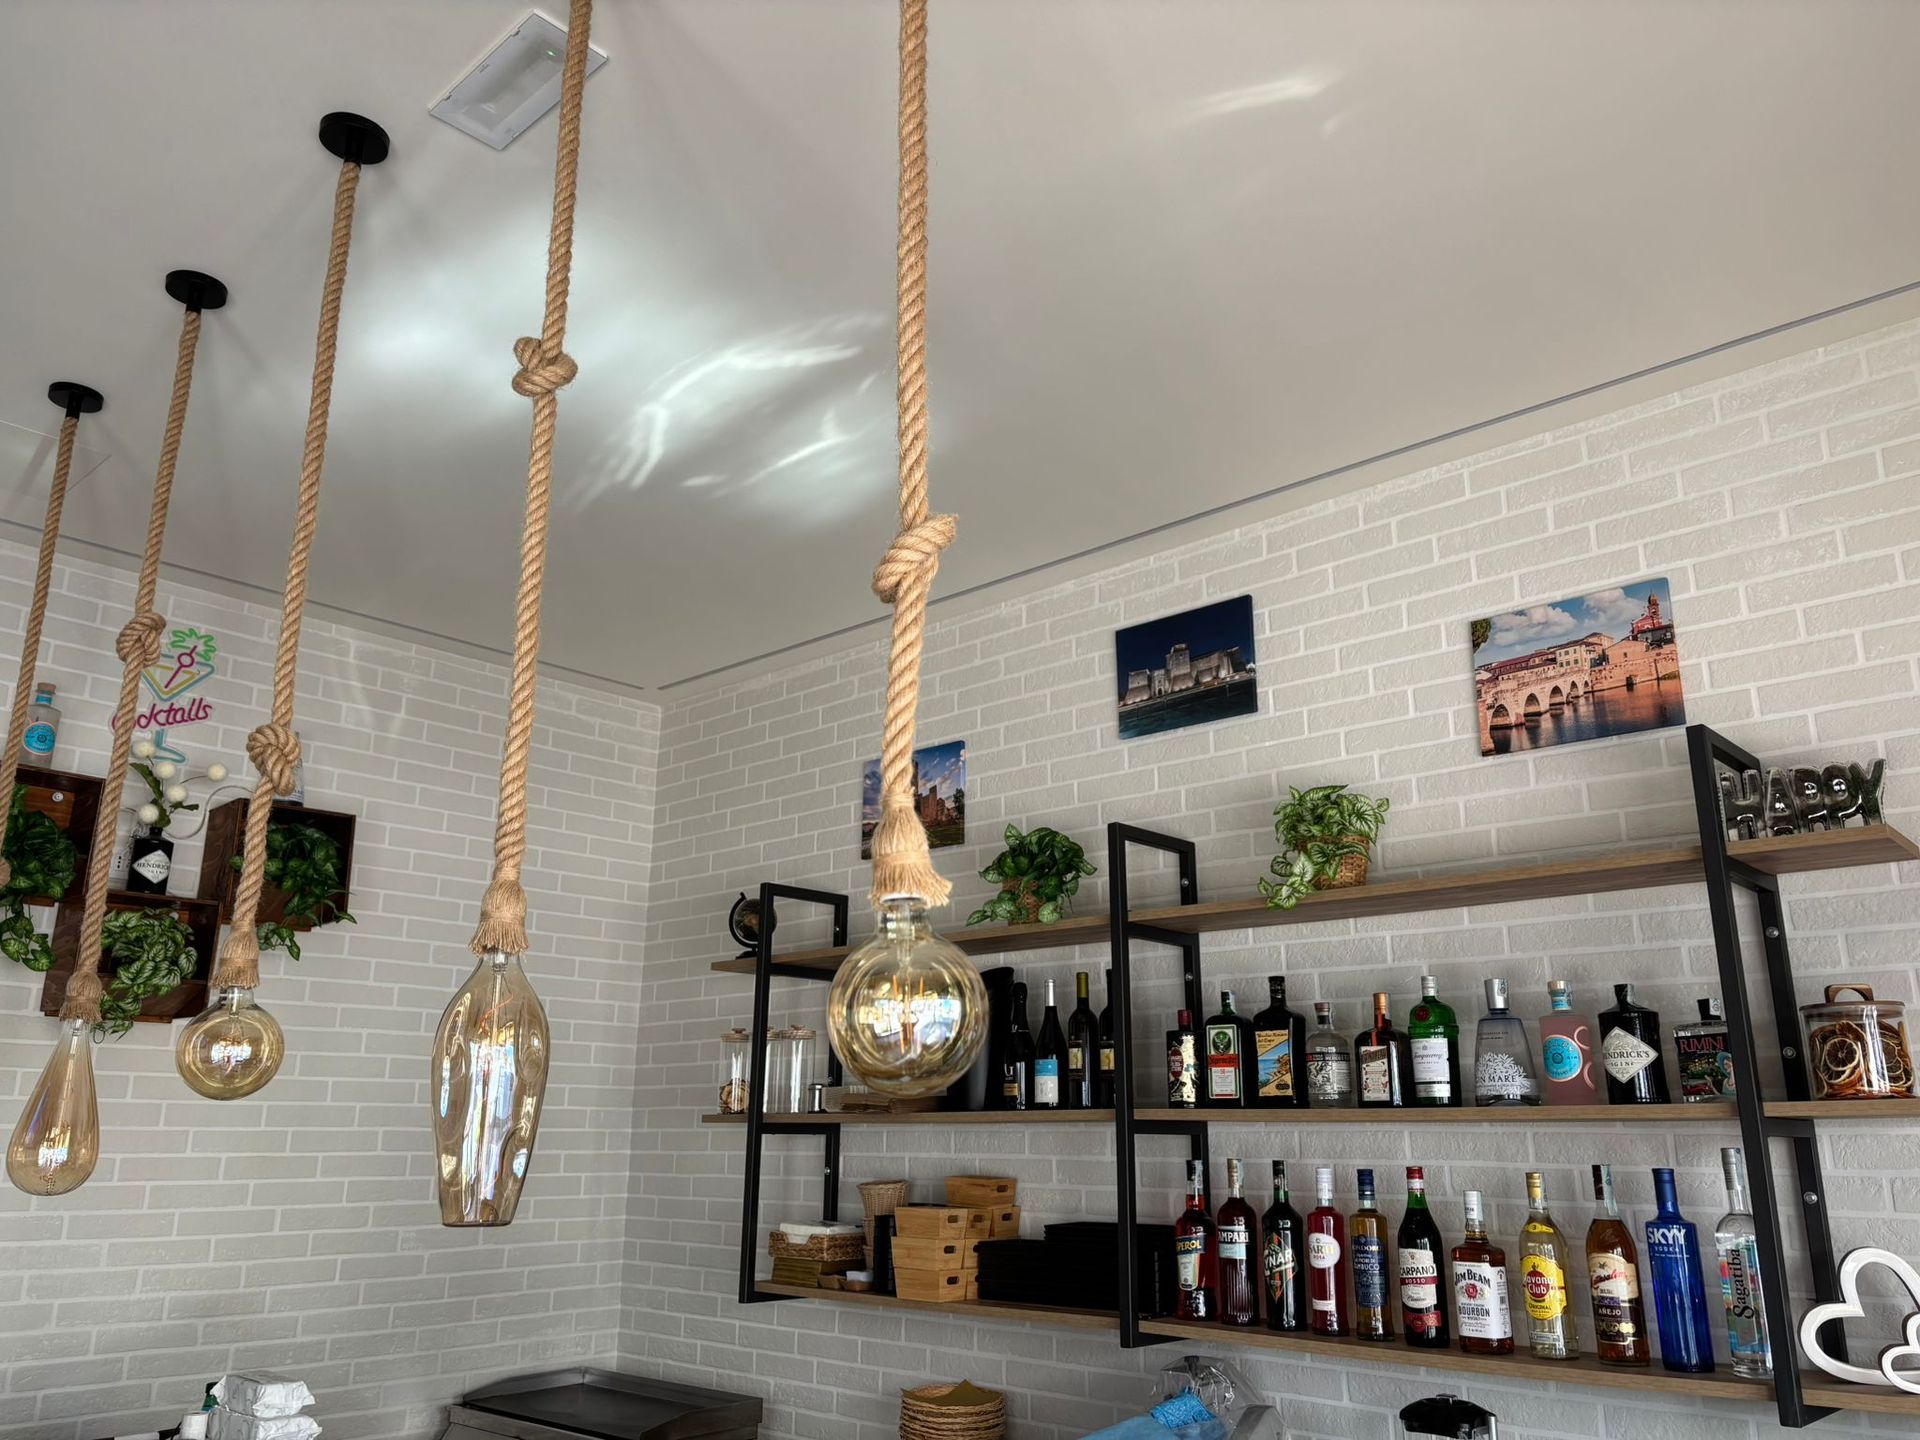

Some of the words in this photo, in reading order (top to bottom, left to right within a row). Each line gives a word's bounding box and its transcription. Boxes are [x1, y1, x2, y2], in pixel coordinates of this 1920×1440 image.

[1680, 1036, 1725, 1052] RIMINI
[1605, 1050, 1650, 1059] NDRICK'S
[1218, 1231, 1249, 1243] AMPARI
[1647, 1227, 1686, 1244] SKYY
[1176, 1240, 1202, 1251] PEROL
[1467, 1268, 1492, 1289] BEAM
[1728, 1249, 1755, 1320] Sagatiba
[1528, 1284, 1547, 1294] Club
[1458, 1305, 1491, 1317] BOURBON
